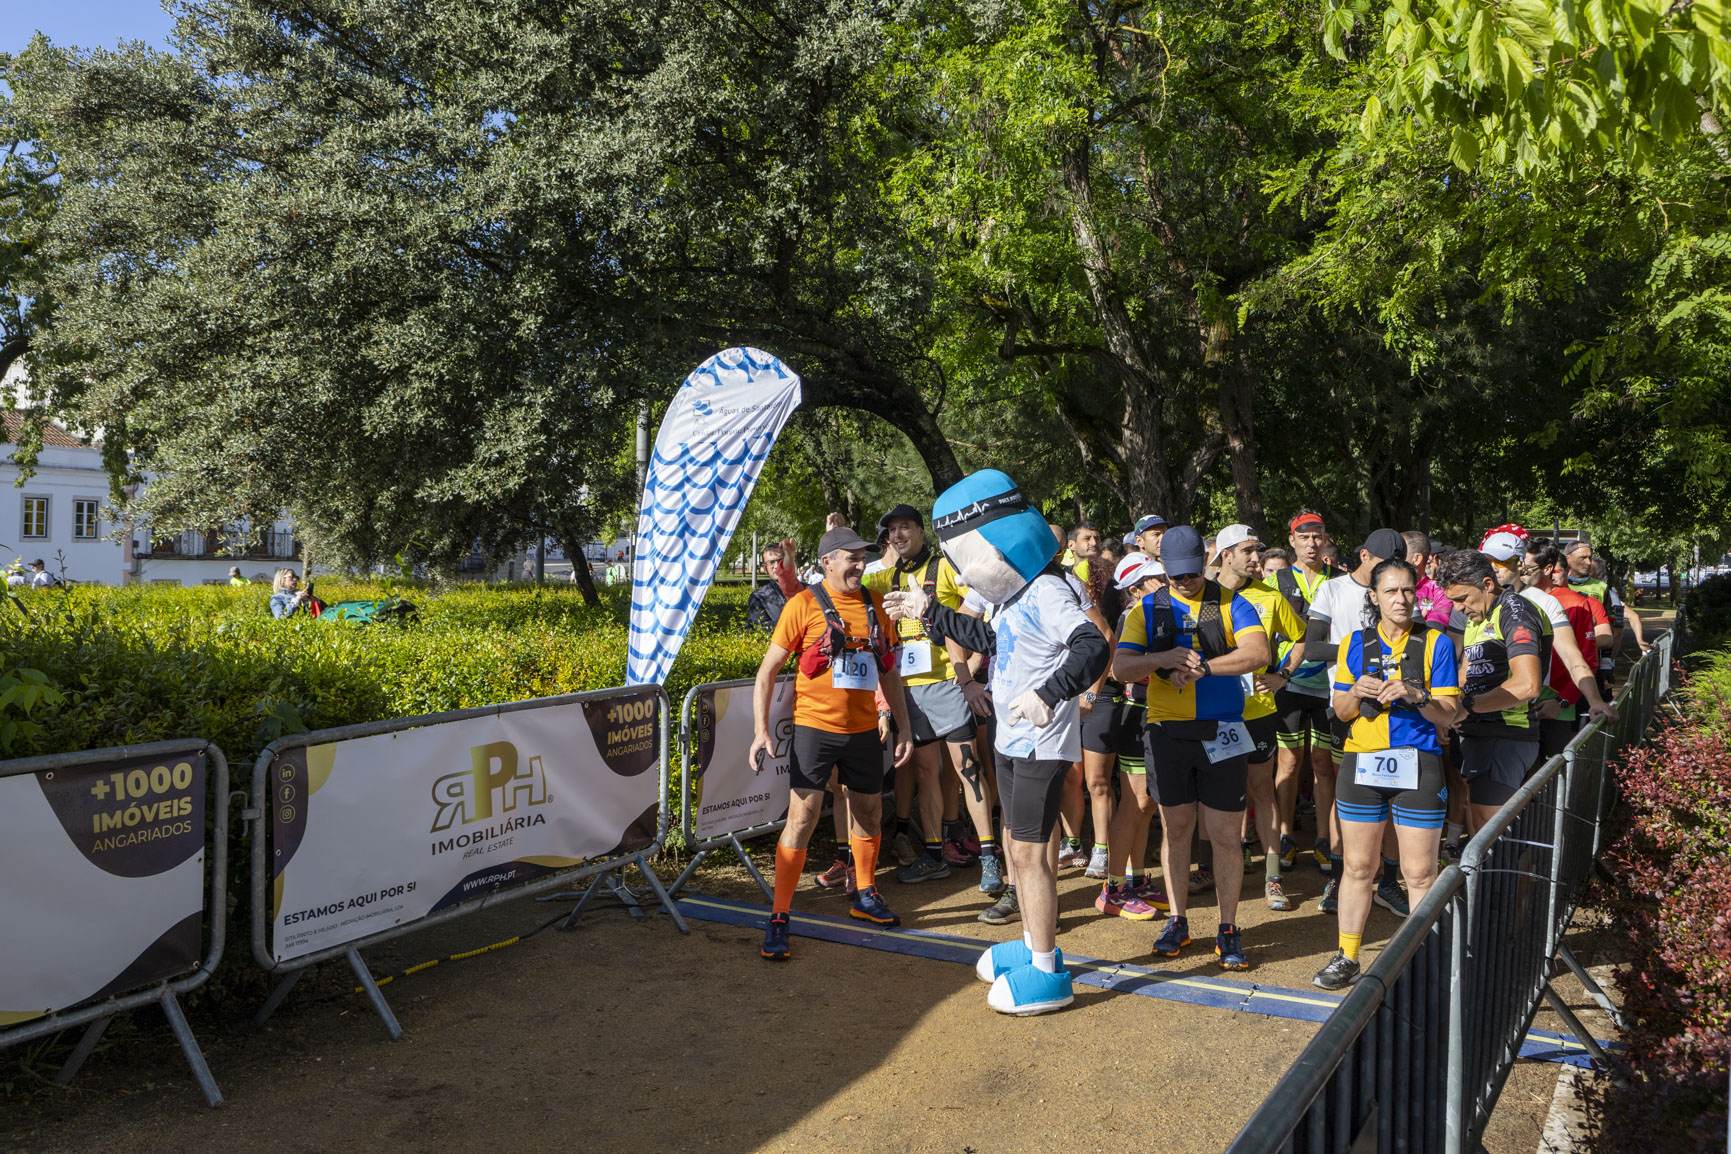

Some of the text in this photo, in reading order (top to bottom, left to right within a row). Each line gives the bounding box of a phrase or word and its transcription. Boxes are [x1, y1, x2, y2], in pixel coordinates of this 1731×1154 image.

[908, 652, 915, 664] 5
[607, 699, 653, 724] +1000
[607, 722, 653, 745] IMÓVEIS
[1219, 728, 1239, 745] 36
[606, 739, 653, 758] ANGARIADOS
[1374, 756, 1398, 774] 70
[90, 762, 193, 800] +1000
[93, 796, 192, 834] IMÓVEIS
[702, 792, 771, 815] ESTAMOS AQUI POR SI
[91, 820, 192, 854] ANGARIADOS
[432, 813, 546, 856] IMOBILIÁRIA
[462, 836, 515, 860] REAL ESTATE
[463, 869, 516, 892] WWW.RPH.PT
[284, 881, 417, 926] ESTAMOS AQUI POR SI
